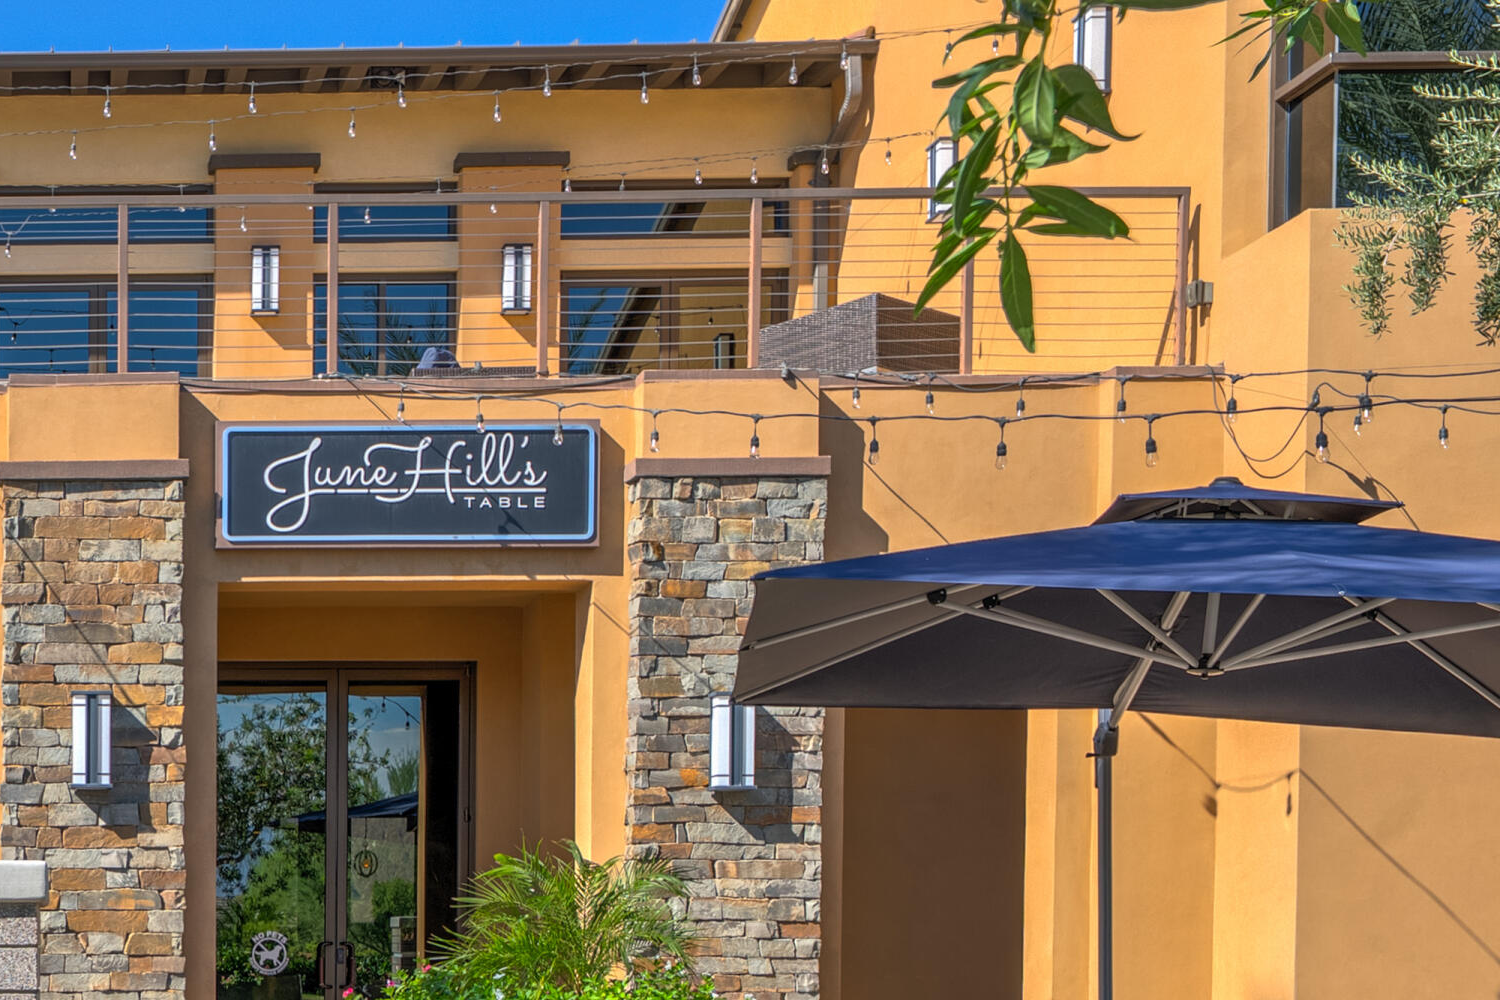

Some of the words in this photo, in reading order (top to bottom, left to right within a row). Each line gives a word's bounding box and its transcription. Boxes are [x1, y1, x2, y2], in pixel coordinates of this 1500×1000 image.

[264, 437, 398, 532] June
[365, 433, 548, 504] Hill's
[464, 496, 546, 509] TABLE
[252, 932, 264, 943] NO
[266, 930, 288, 944] PETS
